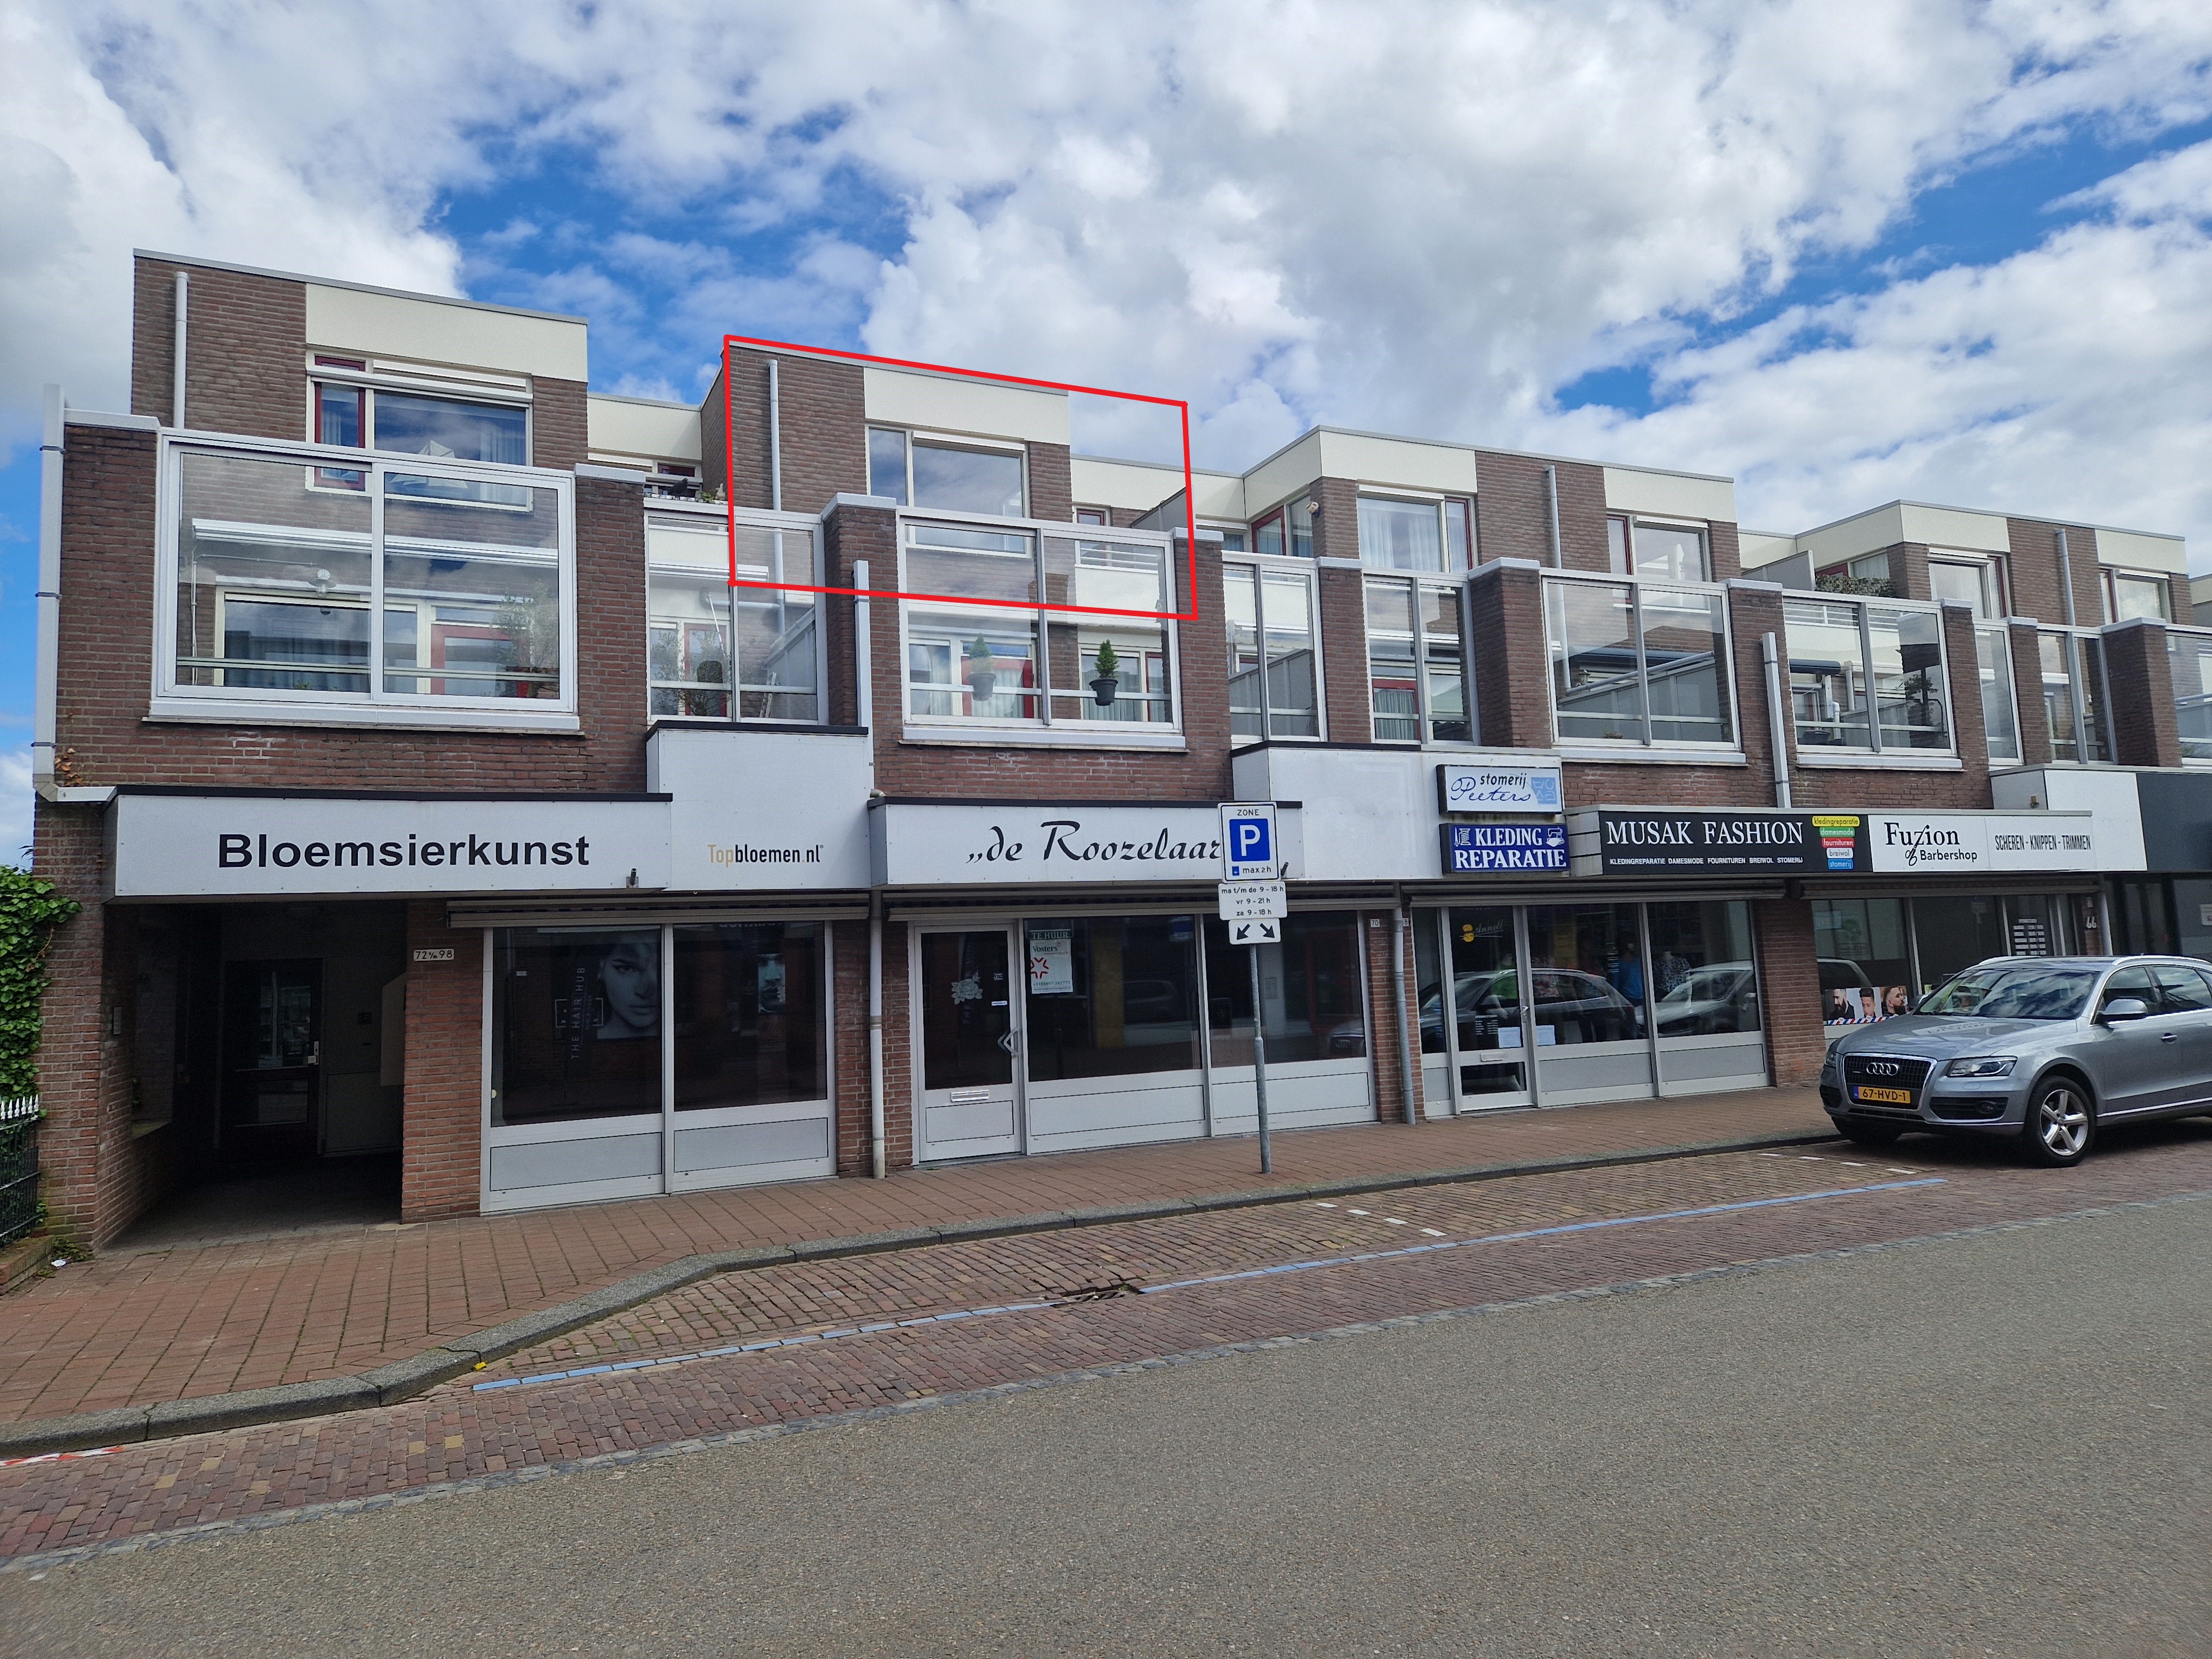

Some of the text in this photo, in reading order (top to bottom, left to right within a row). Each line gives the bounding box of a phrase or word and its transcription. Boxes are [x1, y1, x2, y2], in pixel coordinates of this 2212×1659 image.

[1451, 777, 1531, 801] Peeters
[1480, 773, 1526, 790] stomerij
[1814, 817, 1859, 826] kledingreparatie
[1040, 821, 1221, 860] Roozelaar
[1239, 825, 1261, 857] P
[1475, 828, 1542, 846] KLEDING
[1606, 821, 1803, 844] MUSAK FASHION
[1884, 822, 1960, 848] Fuzion
[219, 833, 589, 868] Bloemsierkunst
[1995, 835, 2025, 851] SCHEREN
[2030, 835, 2057, 850] KNIPPEN
[2062, 835, 2091, 850] TRIMMEN
[707, 844, 820, 868] Topbloemen.nl
[1454, 849, 1567, 869] REPARATIE
[1830, 860, 1851, 869] stomerij
[1921, 849, 1978, 862] Barbershop
[2086, 916, 2096, 928] 66
[439, 950, 452, 958] 98
[571, 968, 585, 1059] THE HAIR HUB
[1863, 1088, 1906, 1101] 67-HVD-1
